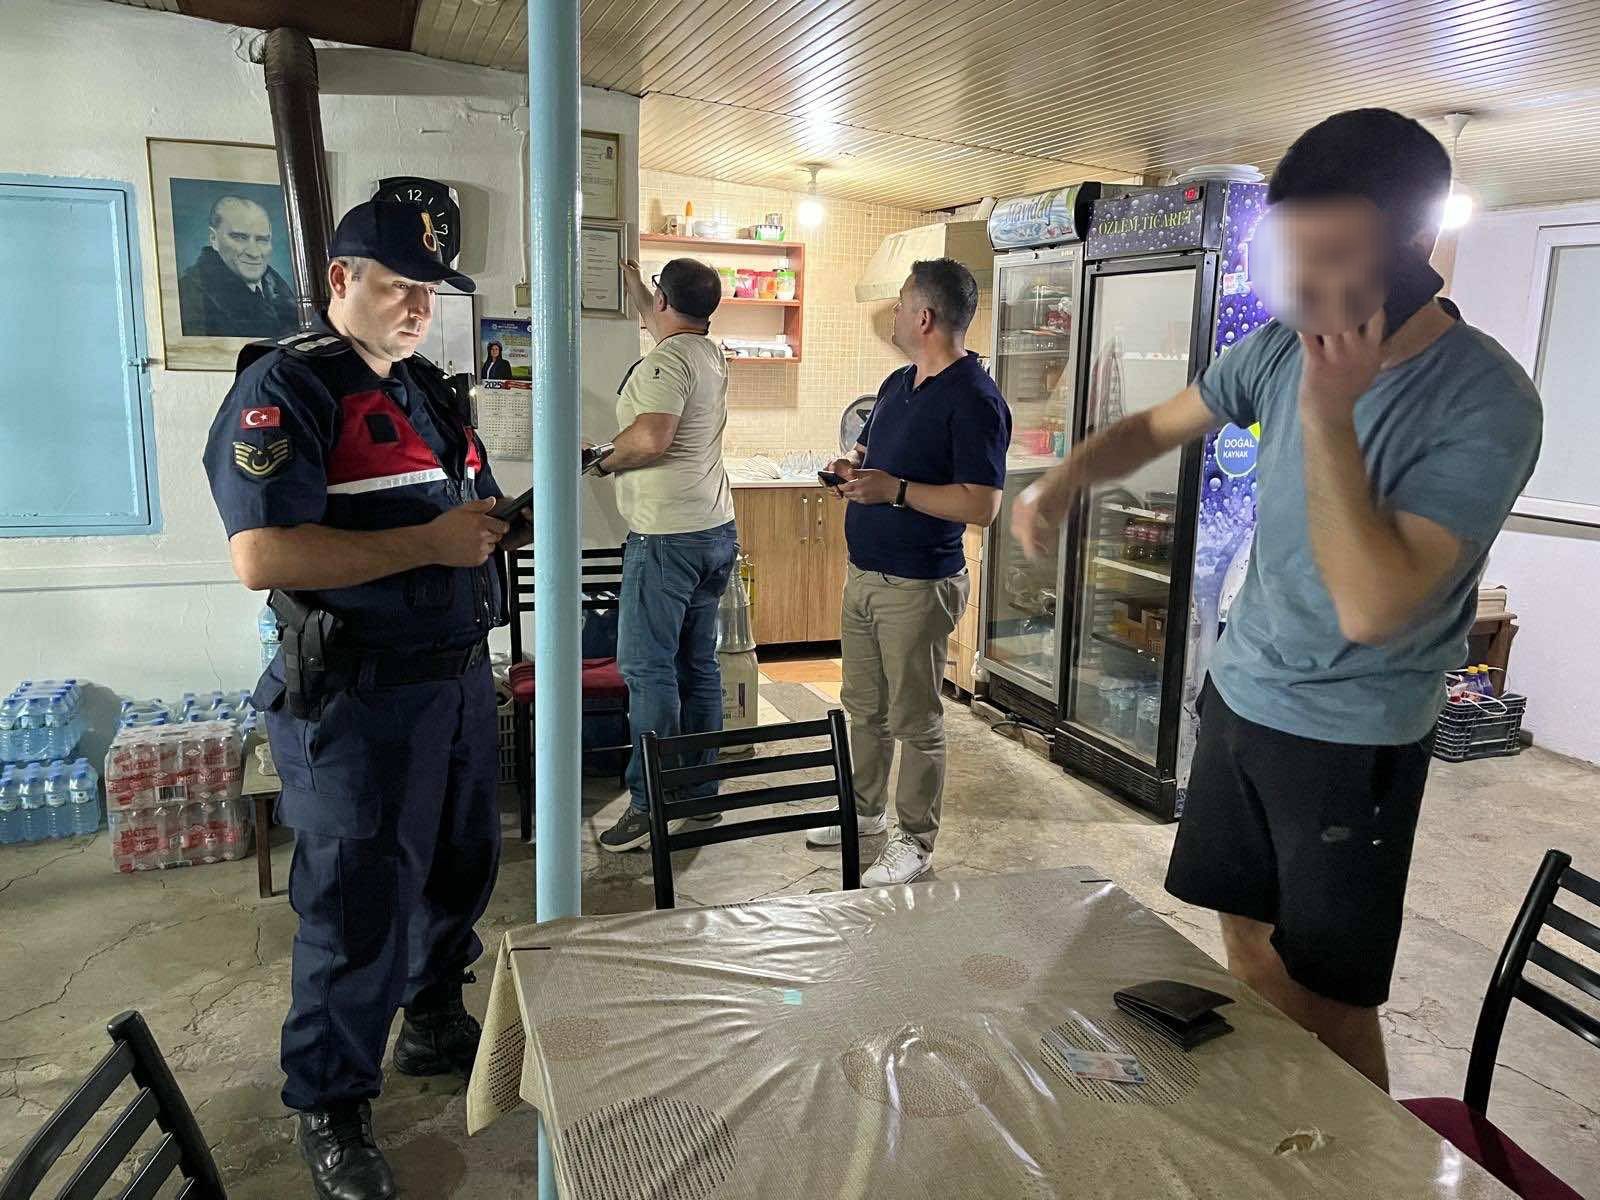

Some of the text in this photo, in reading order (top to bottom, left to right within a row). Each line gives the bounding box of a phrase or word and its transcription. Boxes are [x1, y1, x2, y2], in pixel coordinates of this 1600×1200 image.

[407, 189, 423, 201] 12
[1142, 208, 1194, 230] TİCARET
[484, 380, 502, 390] 2025
[1224, 436, 1255, 448] DOĞAL
[1223, 450, 1249, 459] KAYNAK
